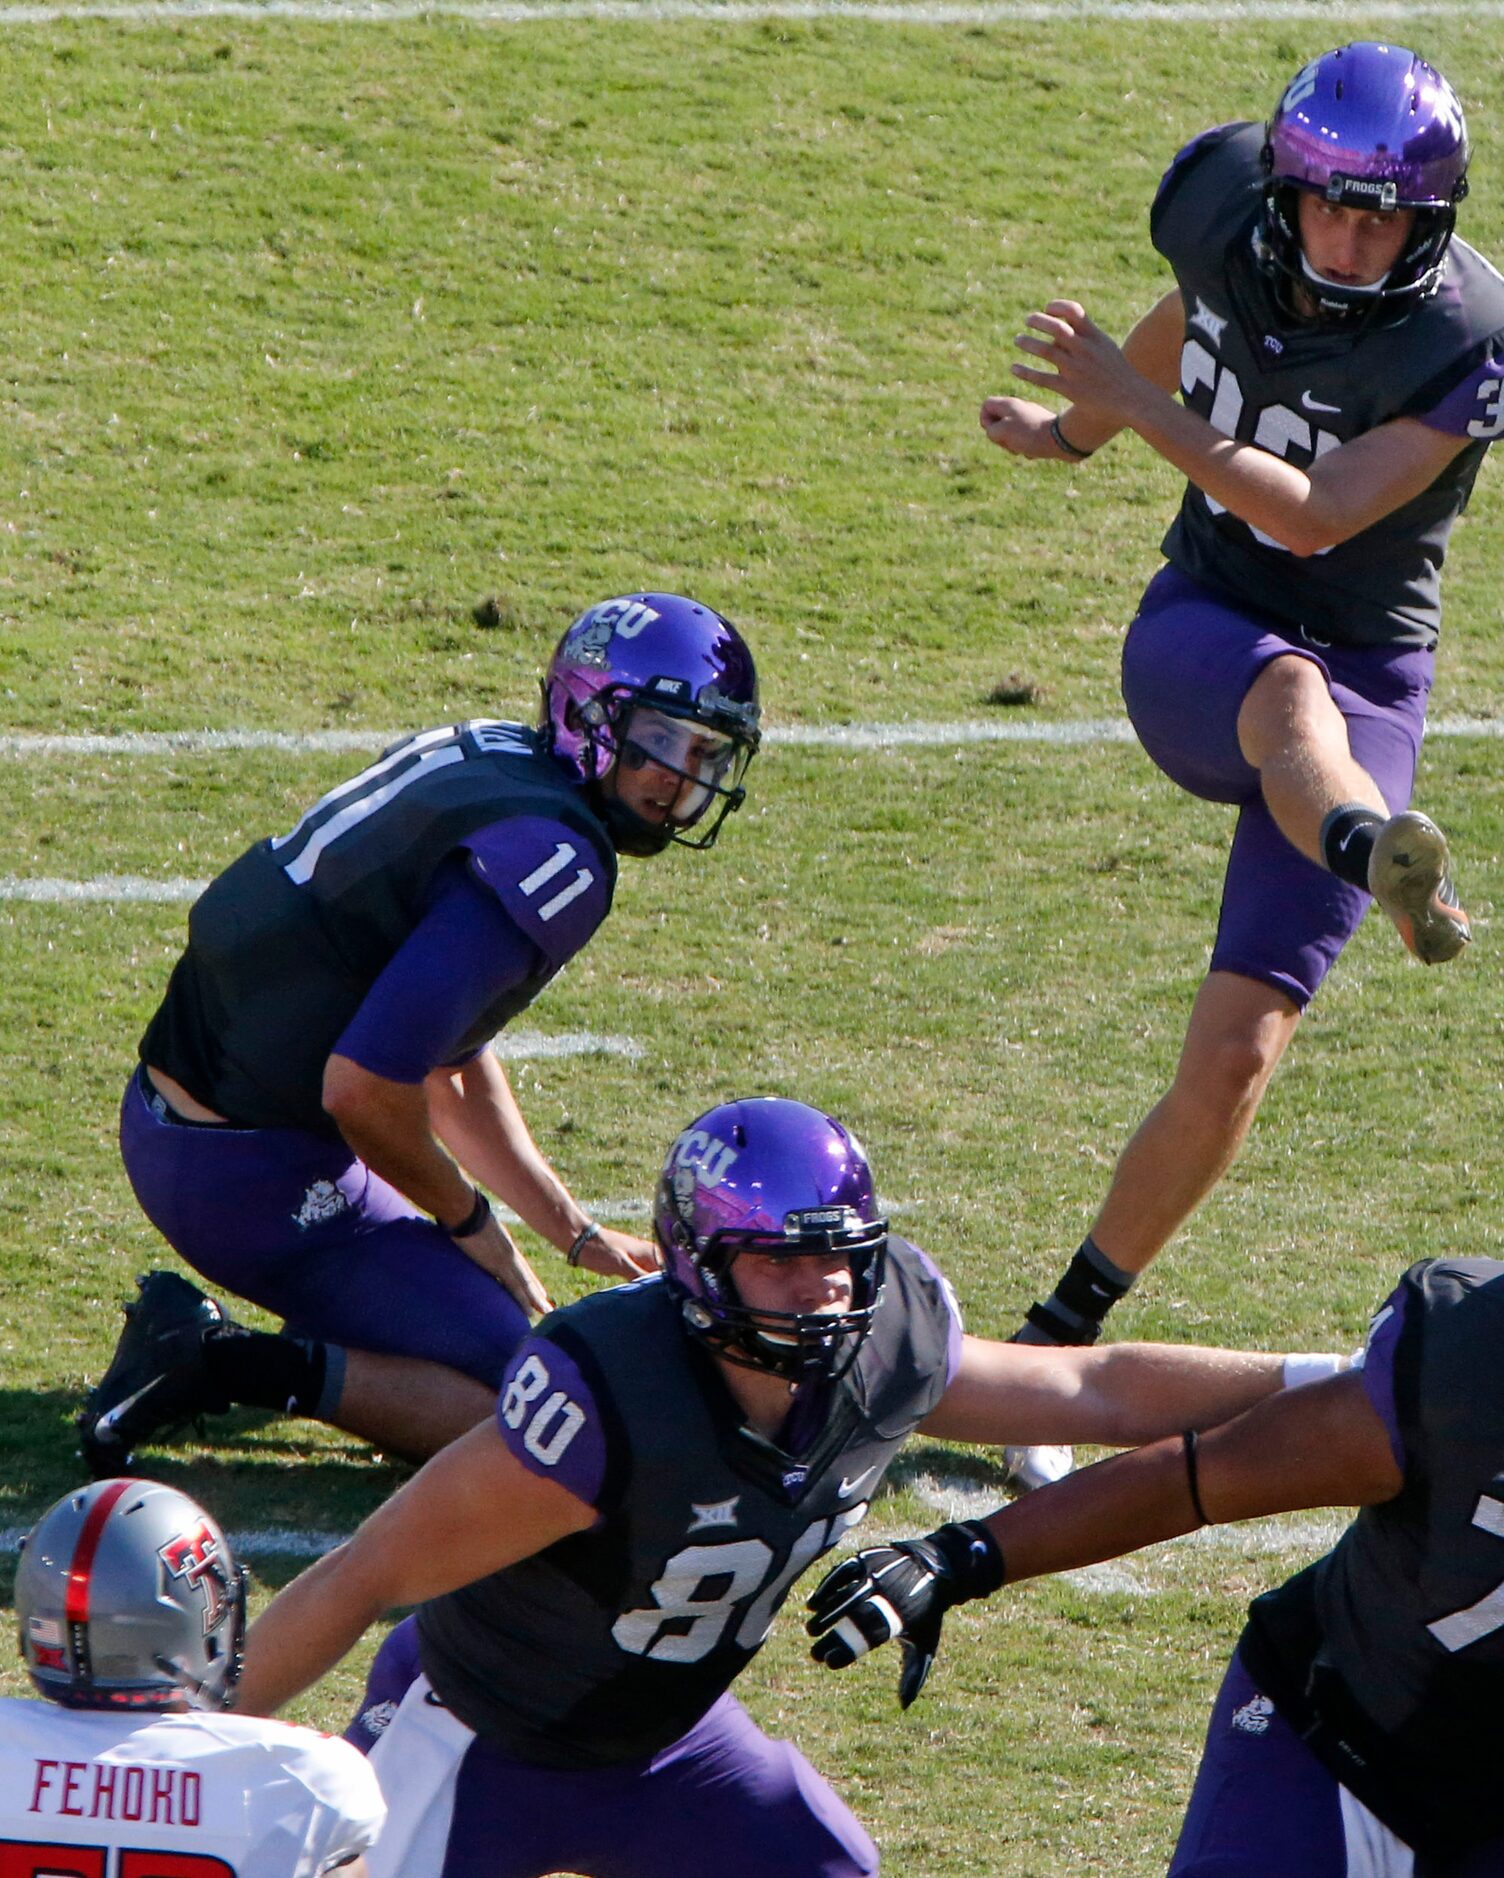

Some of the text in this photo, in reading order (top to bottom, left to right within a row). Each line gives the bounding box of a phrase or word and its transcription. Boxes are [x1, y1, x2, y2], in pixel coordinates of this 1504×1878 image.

[1344, 179, 1384, 195] FROGS
[1264, 334, 1284, 354] TCU
[270, 726, 465, 885] 11
[518, 842, 595, 922] 11
[803, 1212, 841, 1226] FROGS
[502, 1354, 587, 1466] 80
[687, 1495, 741, 1533] XII
[27, 1759, 203, 1827] FEHOKO
